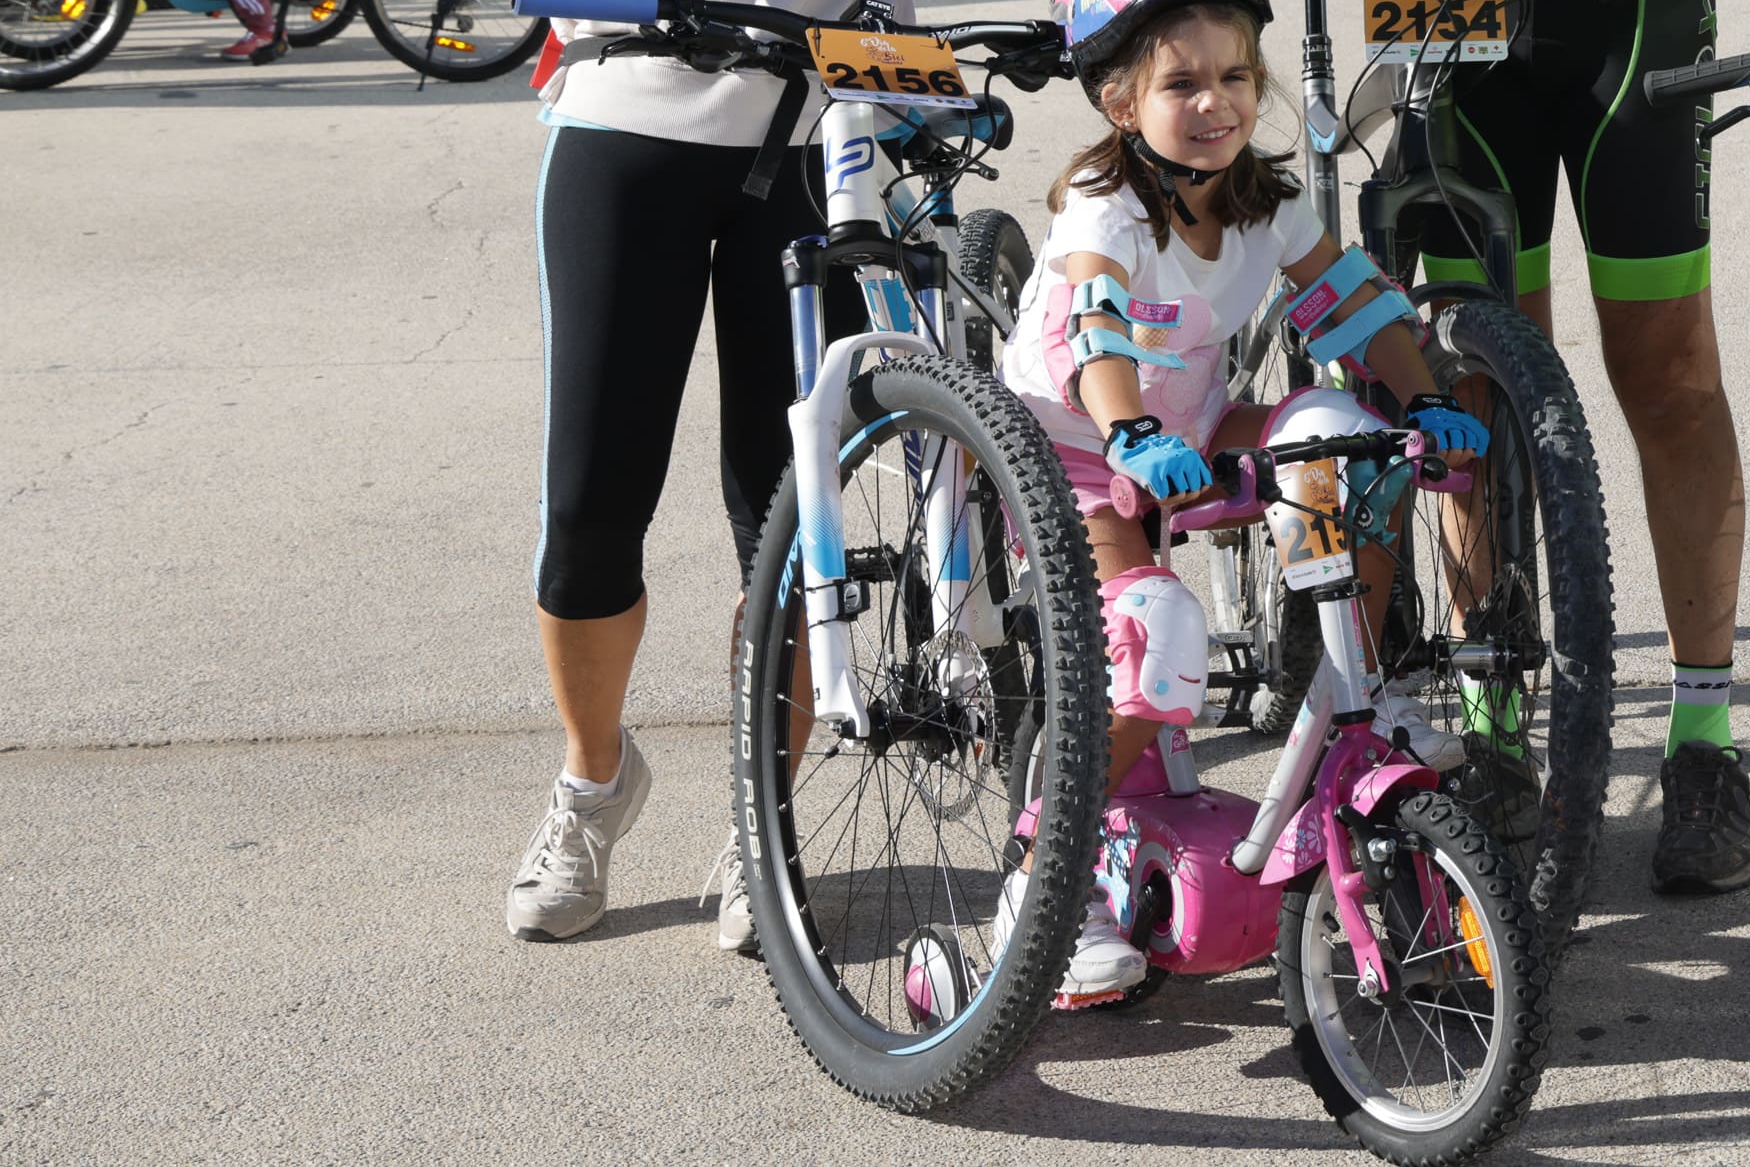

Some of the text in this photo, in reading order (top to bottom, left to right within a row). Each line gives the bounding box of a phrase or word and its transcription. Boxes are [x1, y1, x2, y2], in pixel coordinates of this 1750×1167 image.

[1372, 0, 1502, 41] 2154
[826, 62, 964, 98] 2156
[741, 639, 762, 861] RAPID ROB
